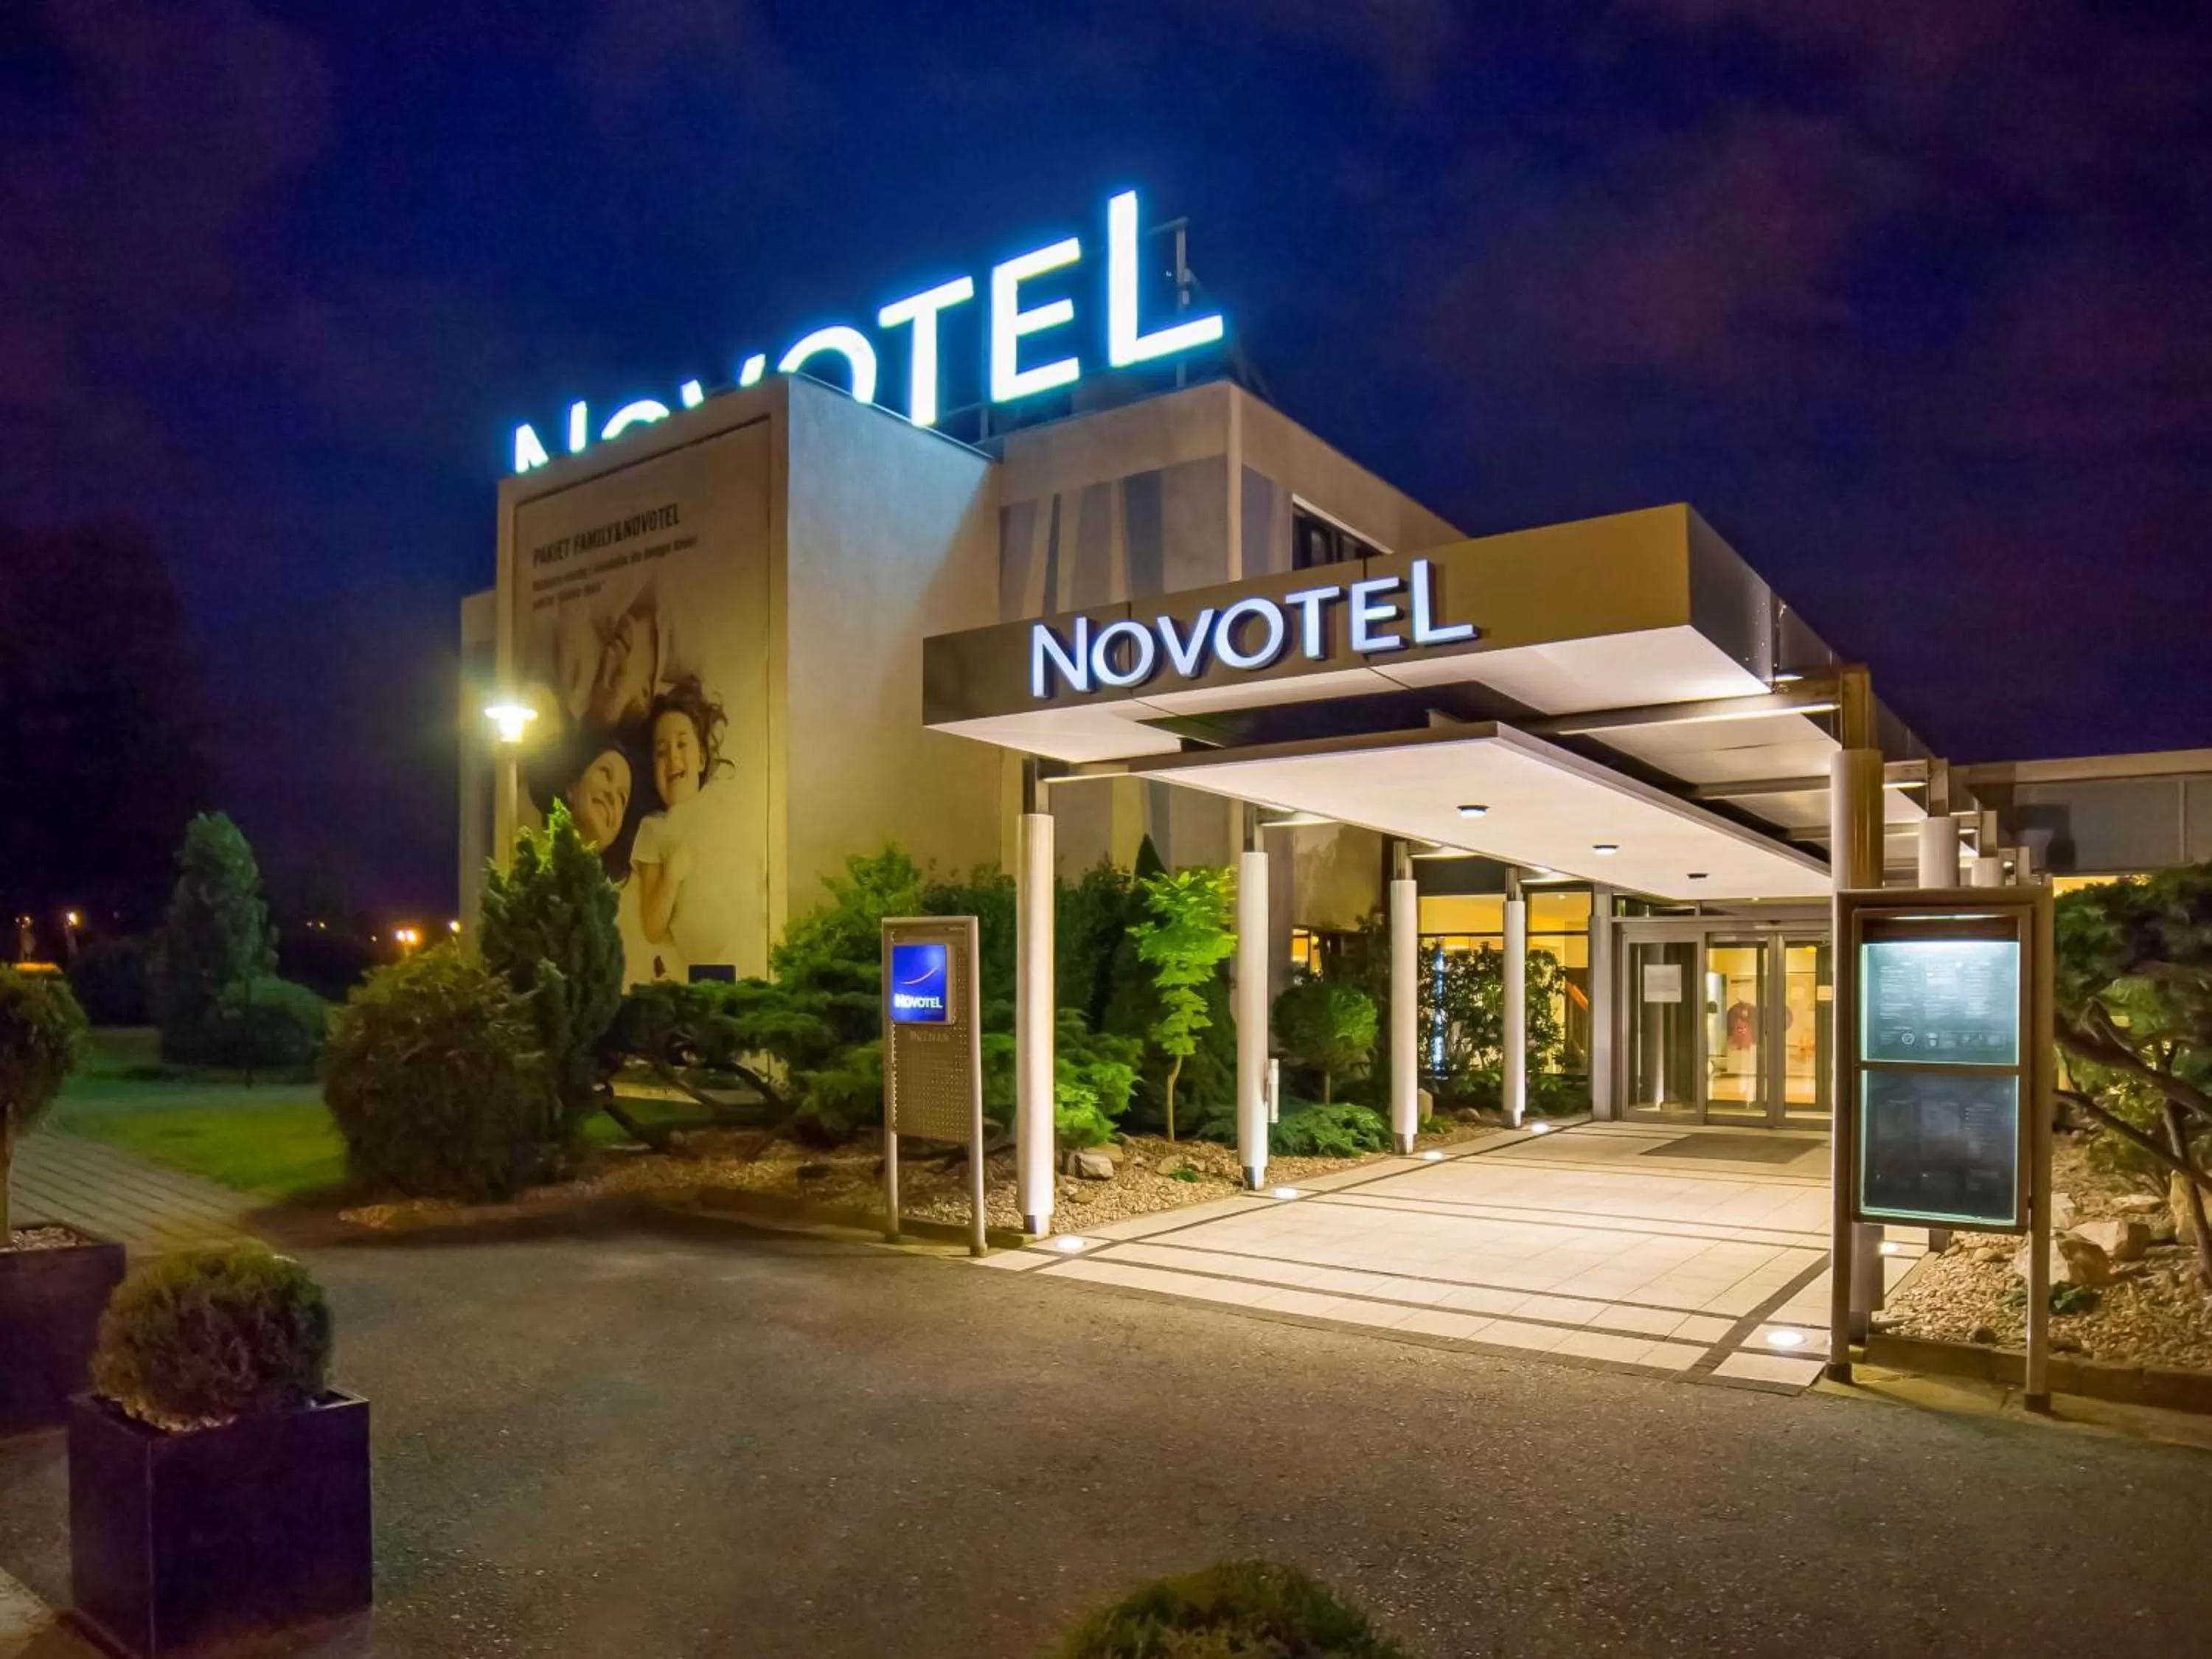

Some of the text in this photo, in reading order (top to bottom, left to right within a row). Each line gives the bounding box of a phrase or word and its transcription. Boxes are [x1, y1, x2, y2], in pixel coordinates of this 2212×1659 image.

[513, 189, 1224, 473] NOTEL
[1032, 558, 1478, 698] NOVOTEL
[894, 994, 944, 1009] NOVOTEL
